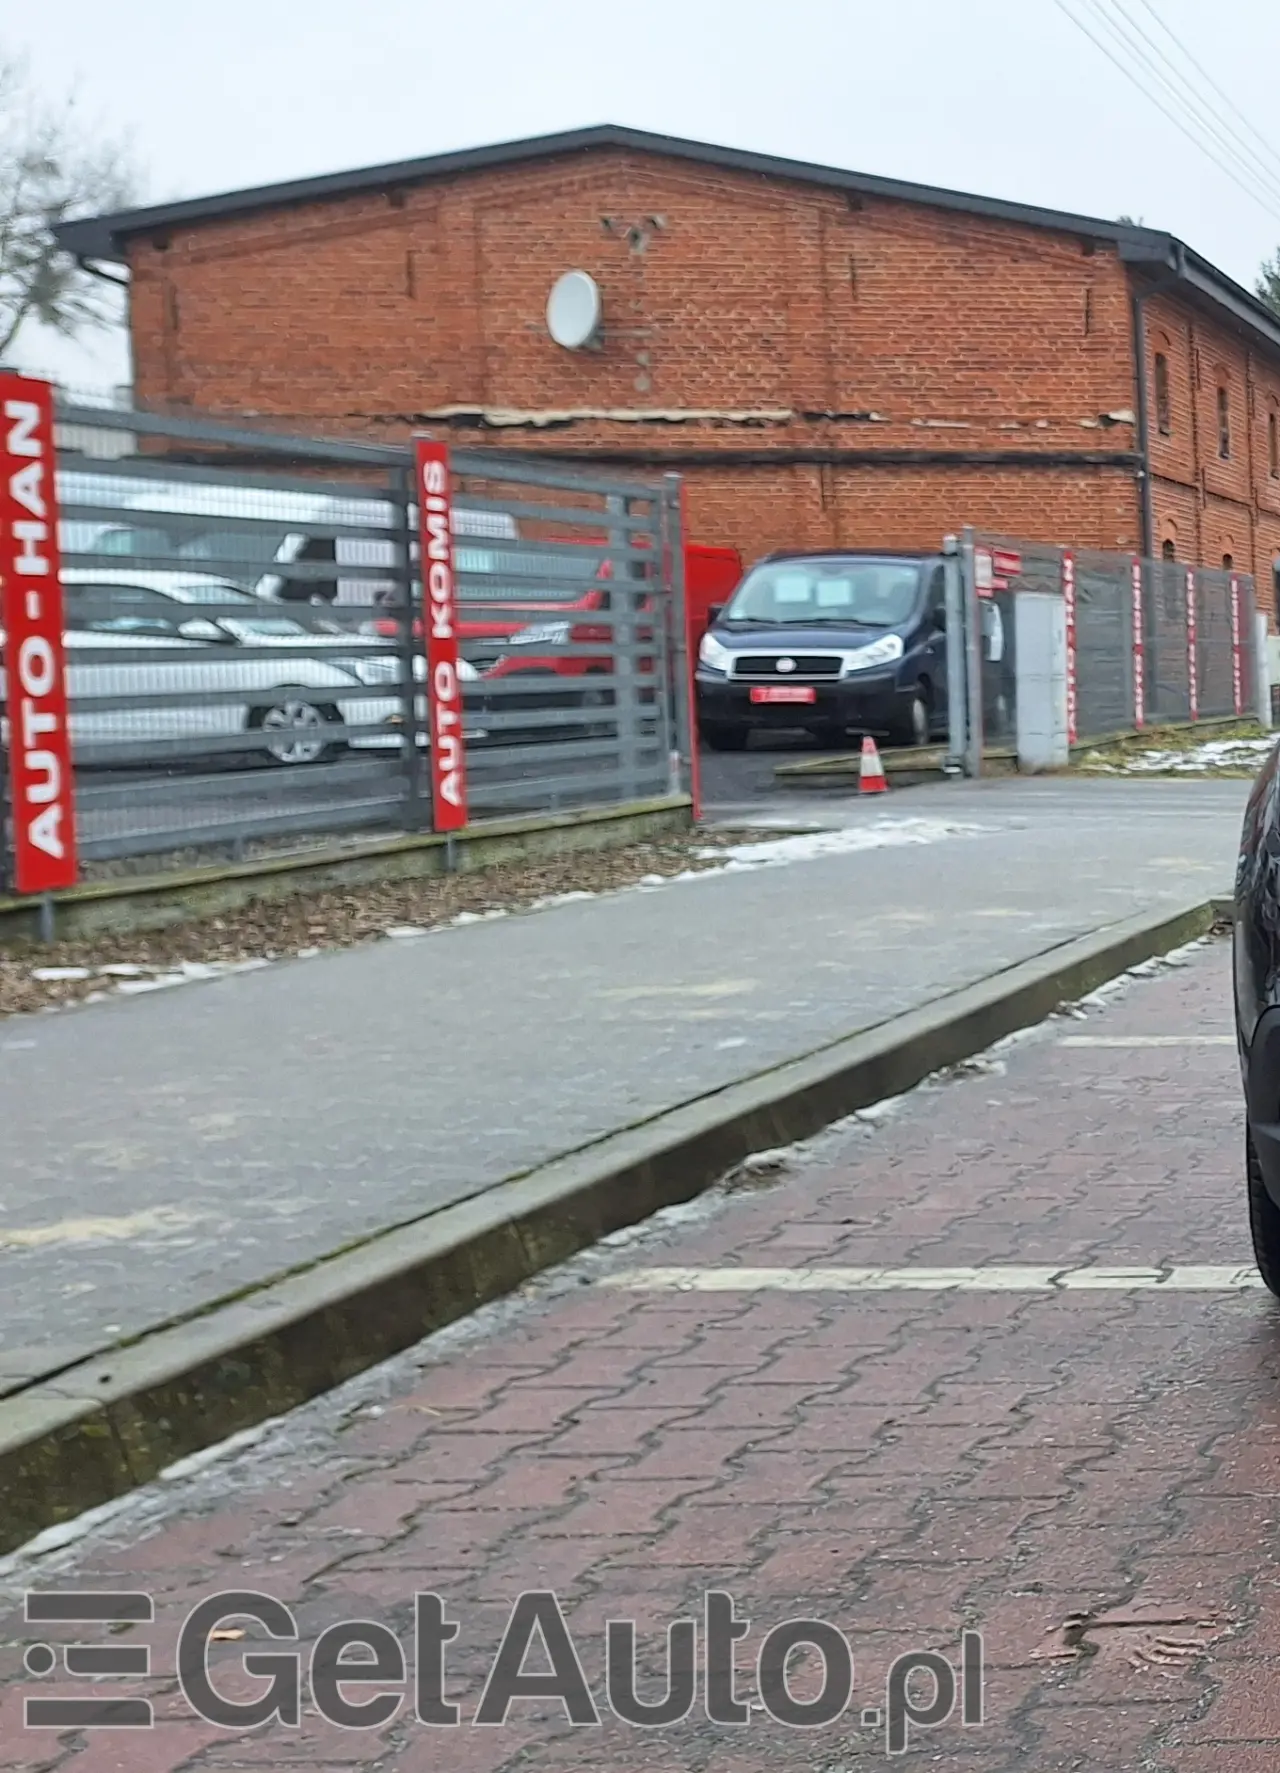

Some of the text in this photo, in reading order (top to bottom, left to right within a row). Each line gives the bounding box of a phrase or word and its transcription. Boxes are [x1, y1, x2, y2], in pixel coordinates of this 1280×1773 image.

[5, 398, 65, 860] AUTO-HAN
[422, 459, 463, 807] AUTO KOMIS
